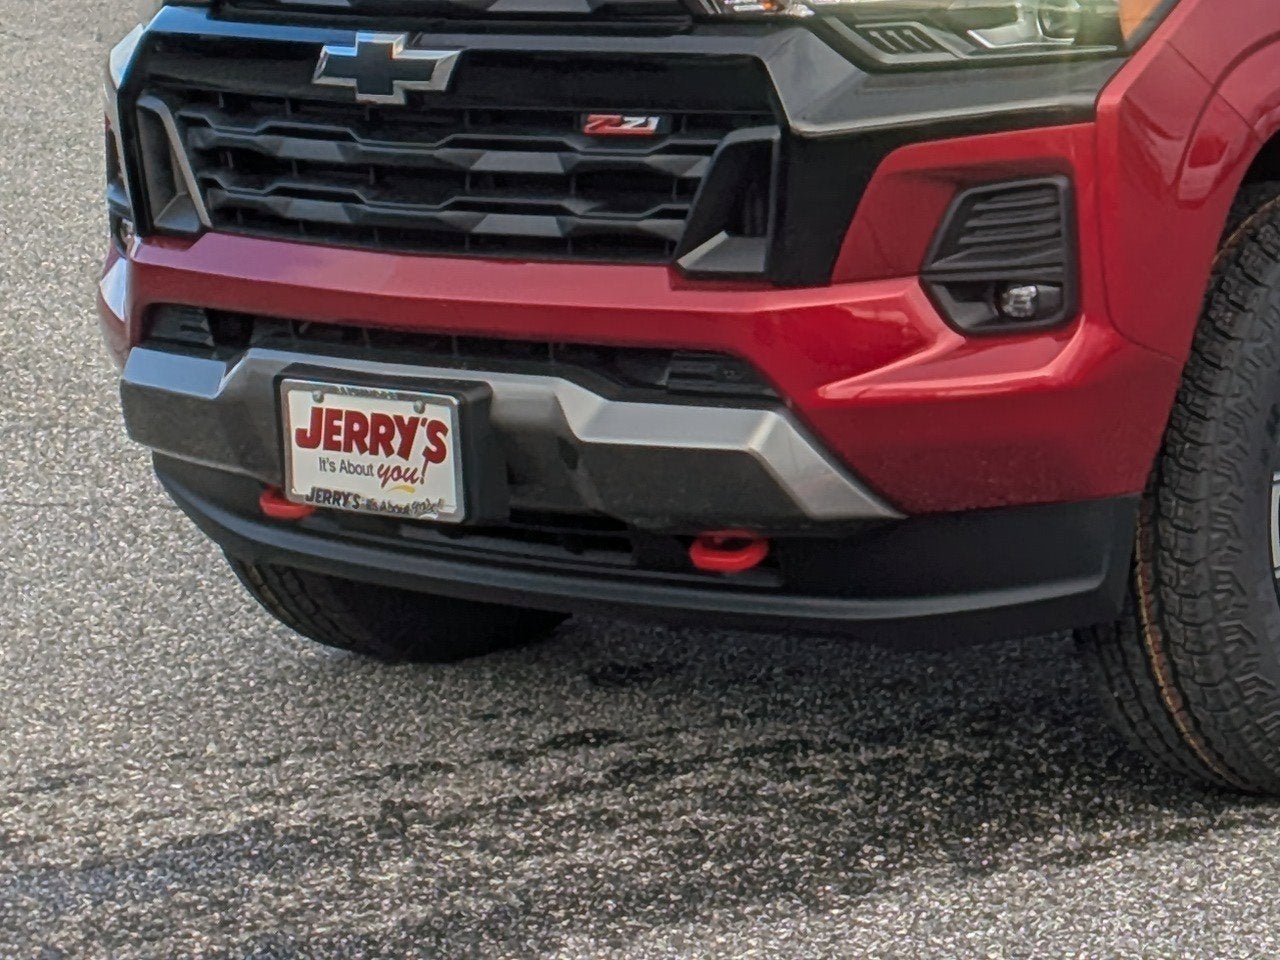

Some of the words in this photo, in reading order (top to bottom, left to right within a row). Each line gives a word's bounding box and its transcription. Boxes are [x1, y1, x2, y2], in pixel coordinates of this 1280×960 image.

[584, 114, 660, 136] Z71
[295, 406, 449, 464] JERRY'S
[318, 457, 336, 473] It's
[339, 459, 374, 477] About
[376, 458, 429, 489] you!
